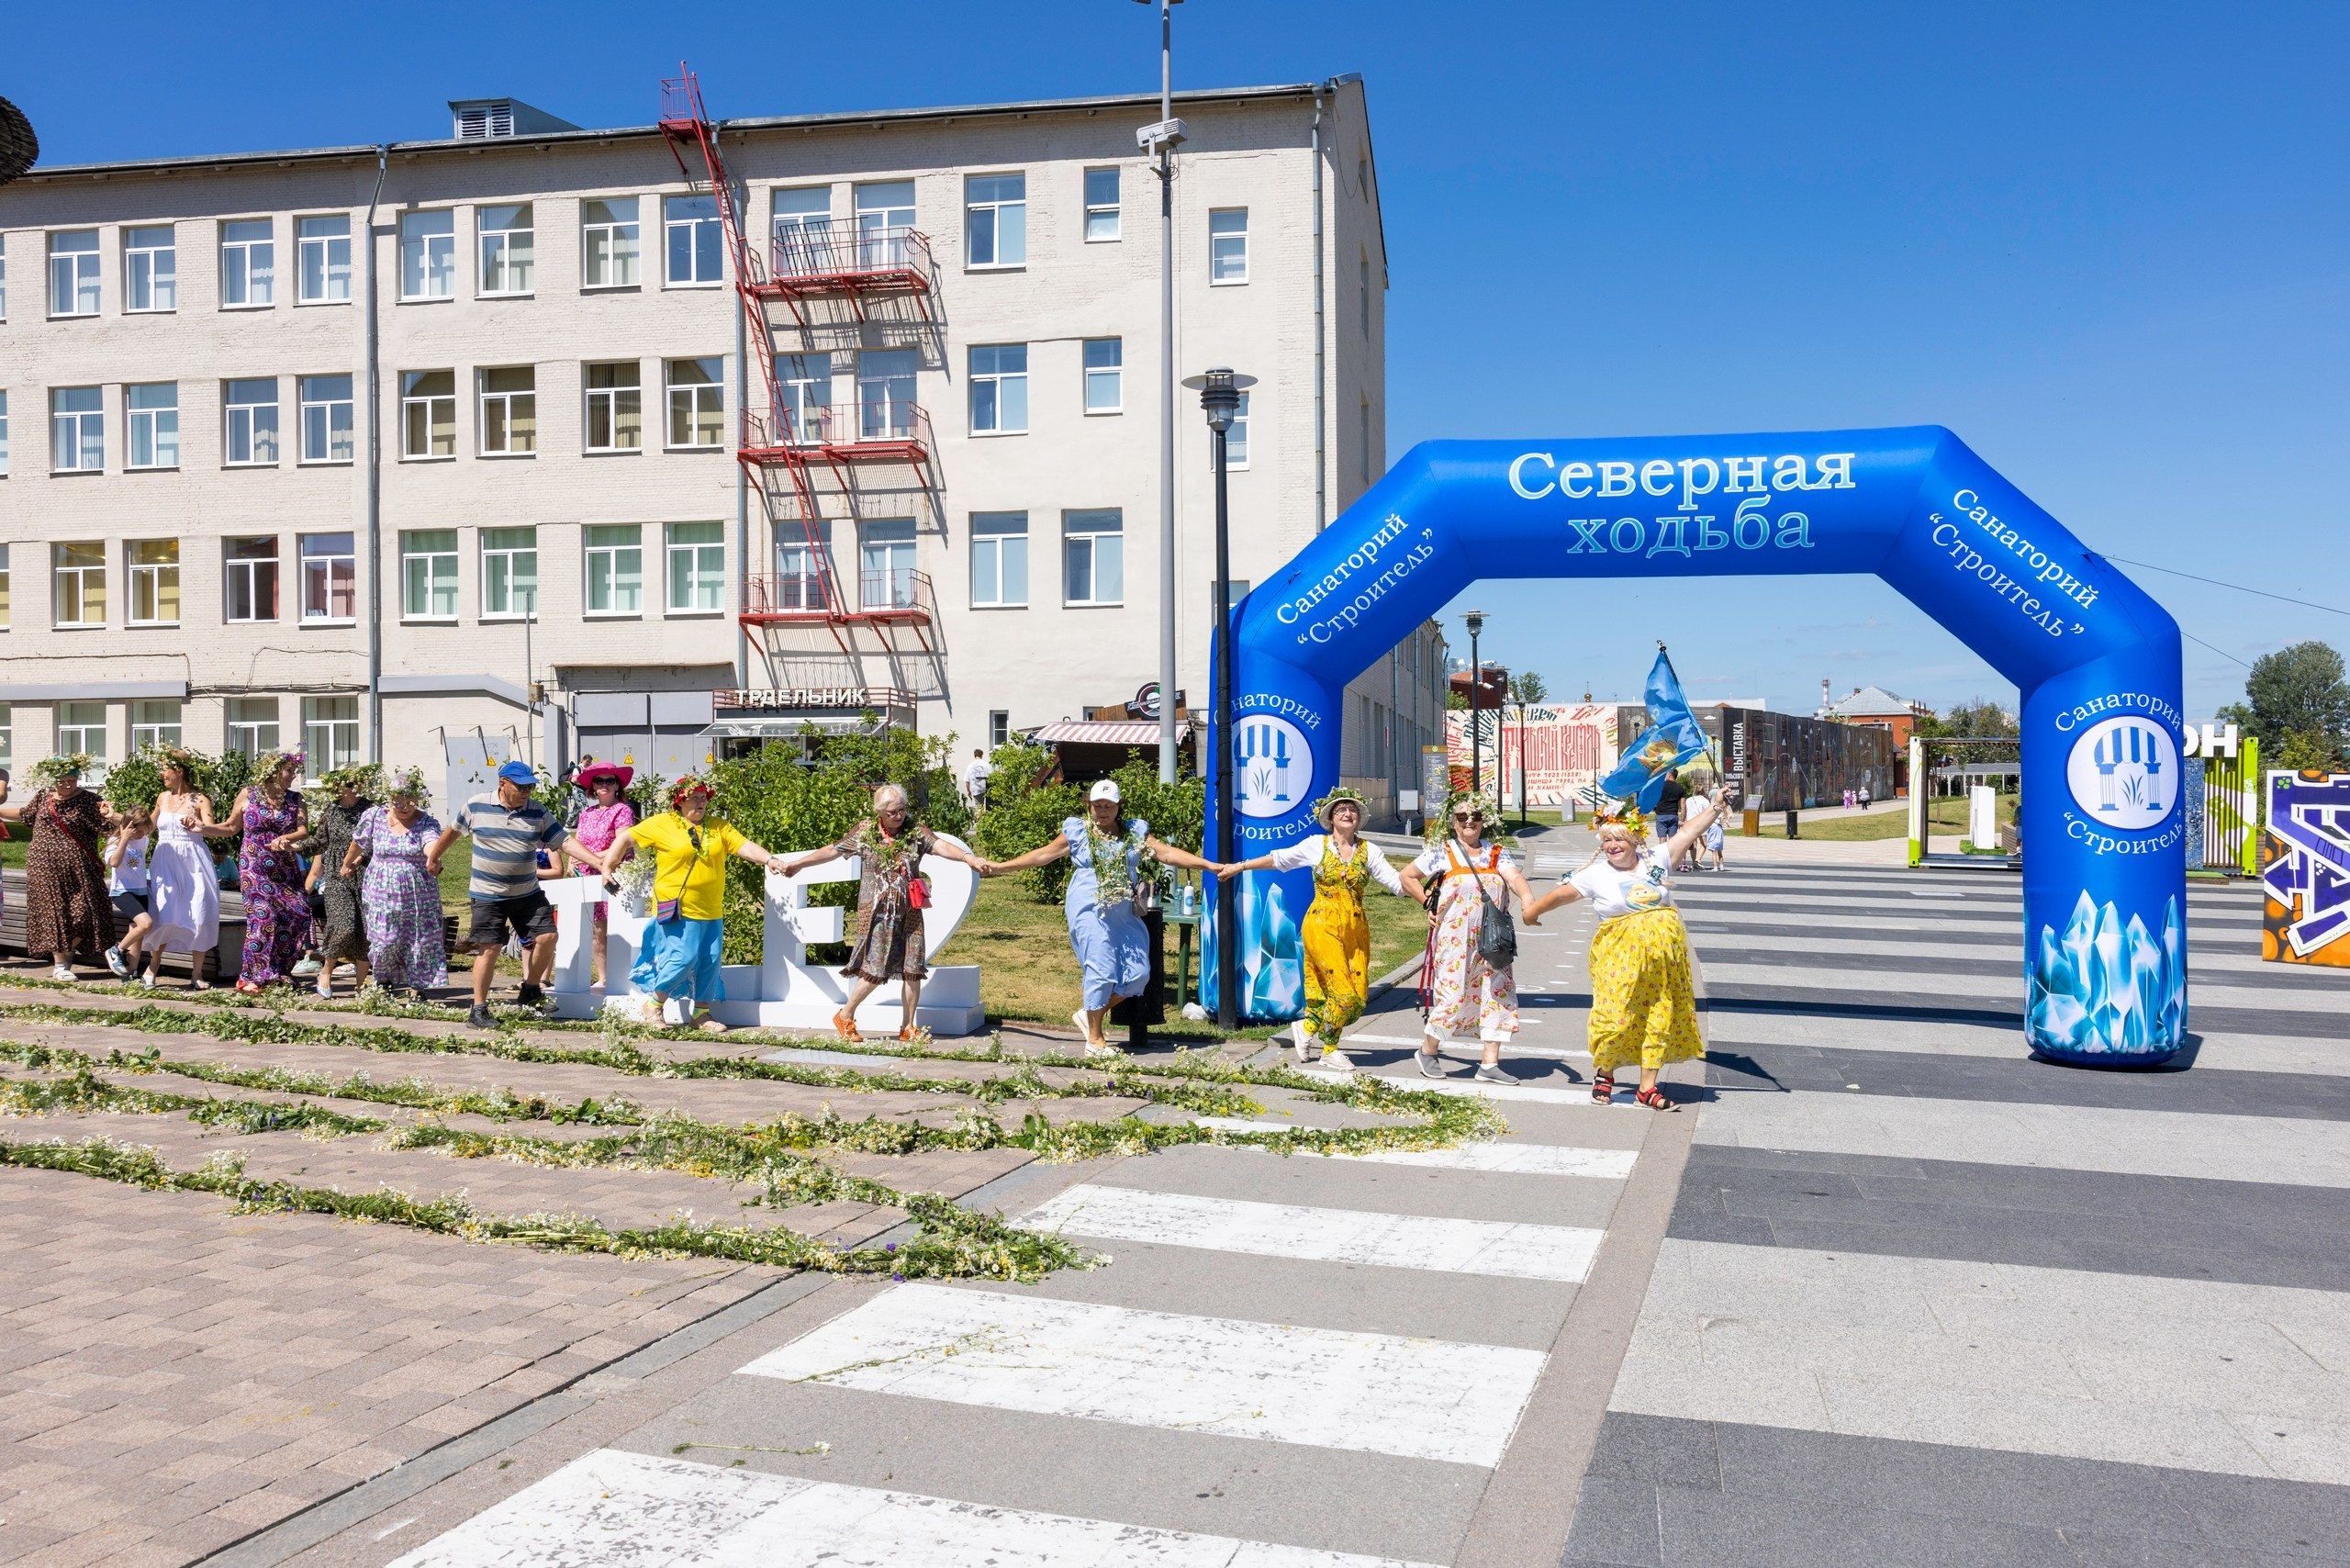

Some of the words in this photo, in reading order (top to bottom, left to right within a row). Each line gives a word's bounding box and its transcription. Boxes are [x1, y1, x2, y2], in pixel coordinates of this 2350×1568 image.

[1508, 452, 1856, 510] Северная
[1567, 494, 1816, 559] ходьба
[1953, 487, 2099, 610] Санаторий
[1276, 513, 1408, 625] Санаторий
[735, 689, 866, 707] ТРДЕЛЬНИК
[1214, 693, 1322, 732] наторий
[2055, 692, 2182, 733] Санаторий
[1732, 722, 1744, 771] ВЫСТАВКА
